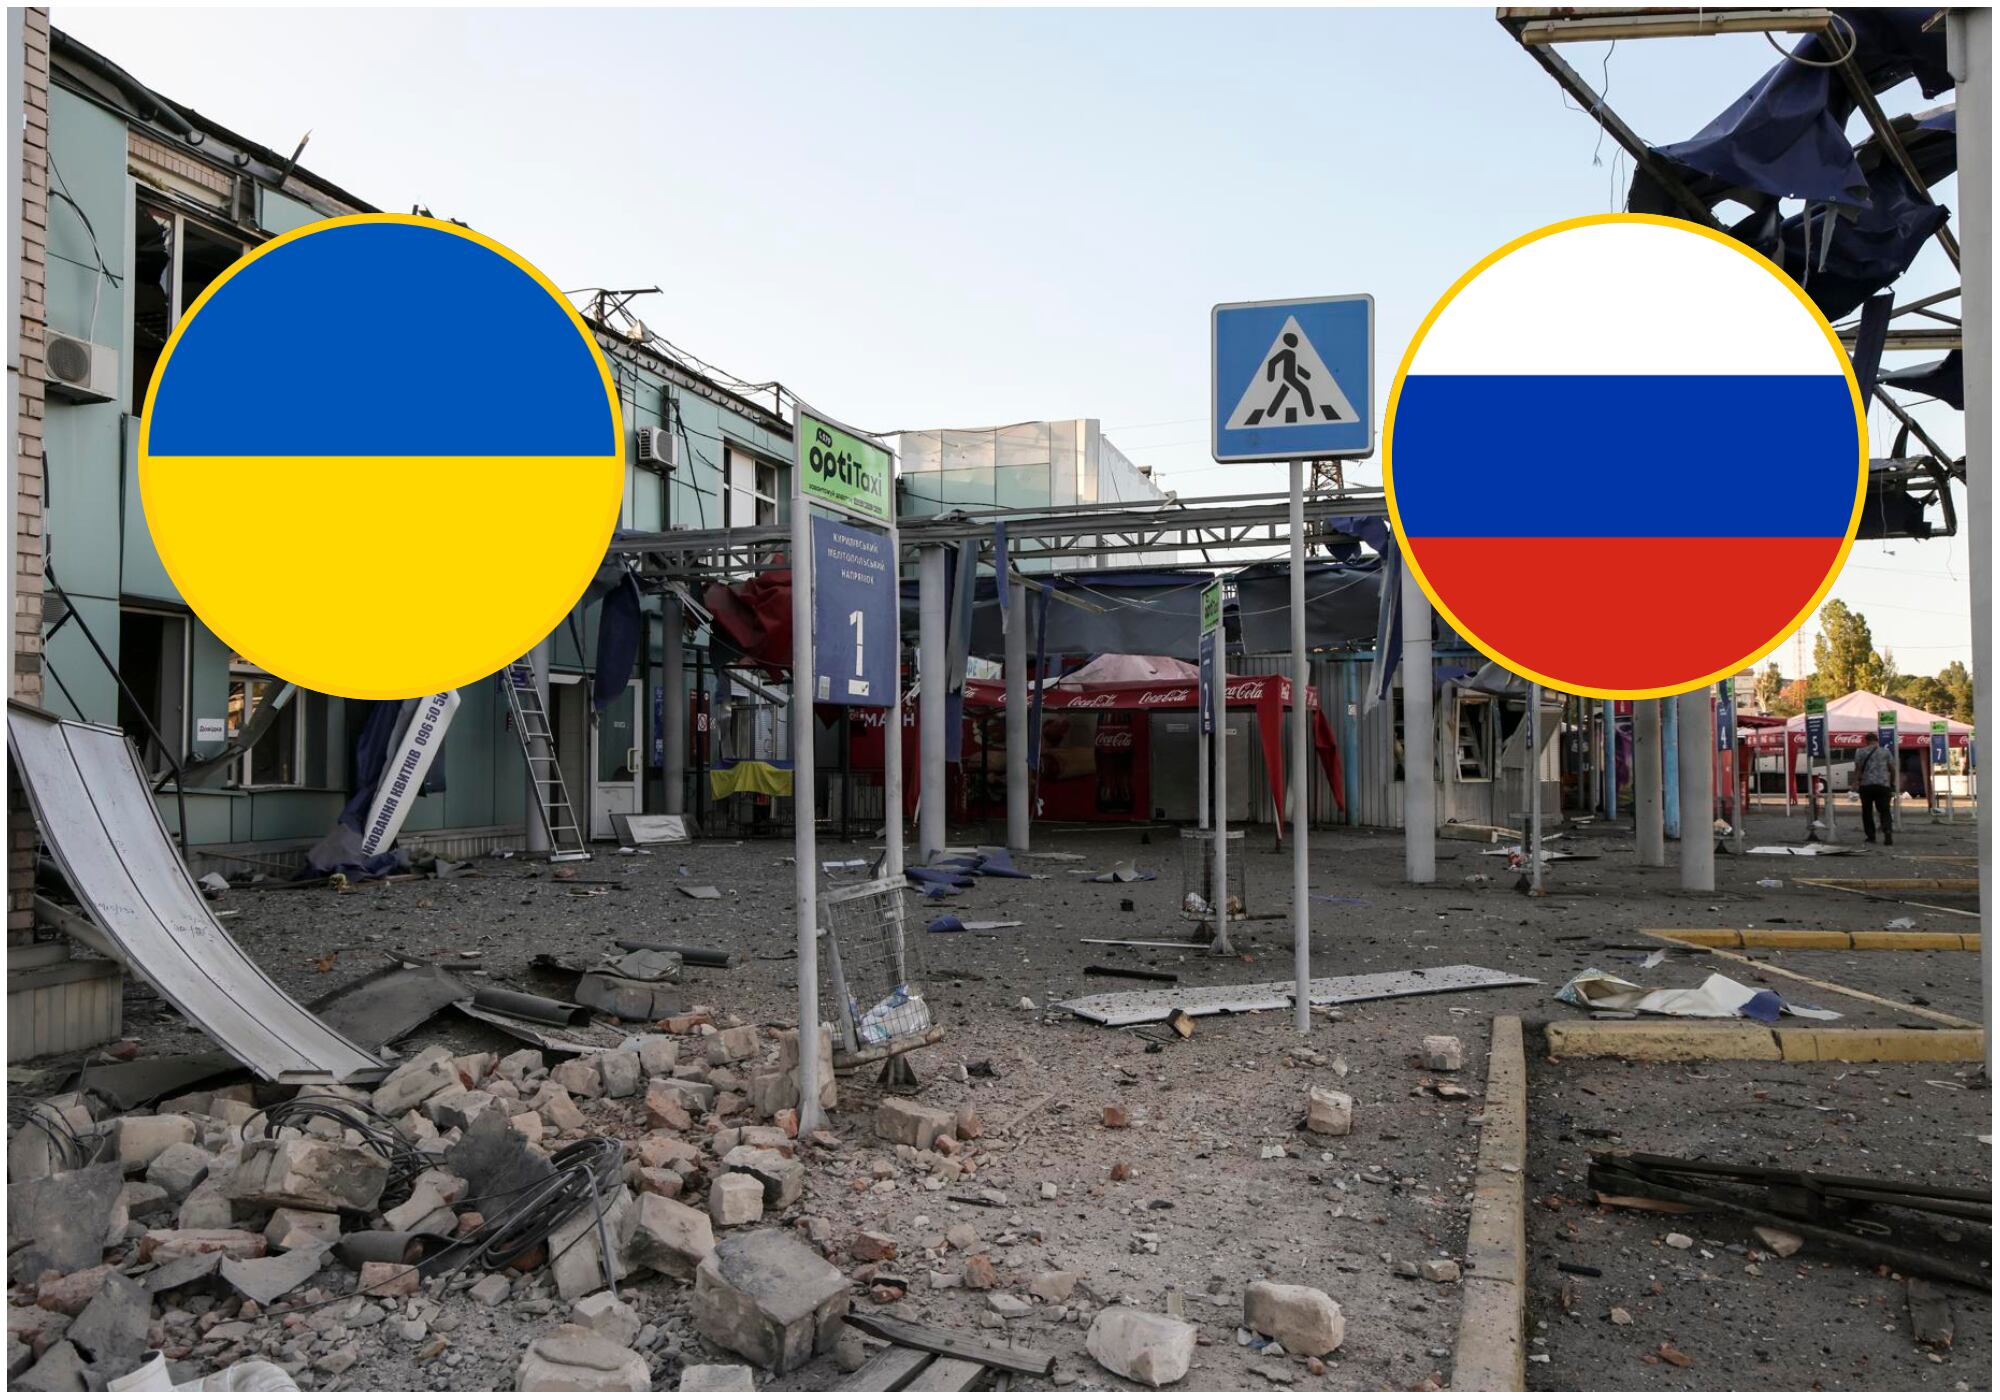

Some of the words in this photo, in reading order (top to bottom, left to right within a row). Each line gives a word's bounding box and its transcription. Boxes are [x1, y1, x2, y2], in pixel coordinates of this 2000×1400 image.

[849, 610, 864, 676] 1
[390, 749, 422, 798] КВИТКІВ
[415, 722, 434, 746] 096
[425, 706, 441, 723] 50
[1812, 736, 1819, 751] 5
[1936, 749, 1942, 760] 7
